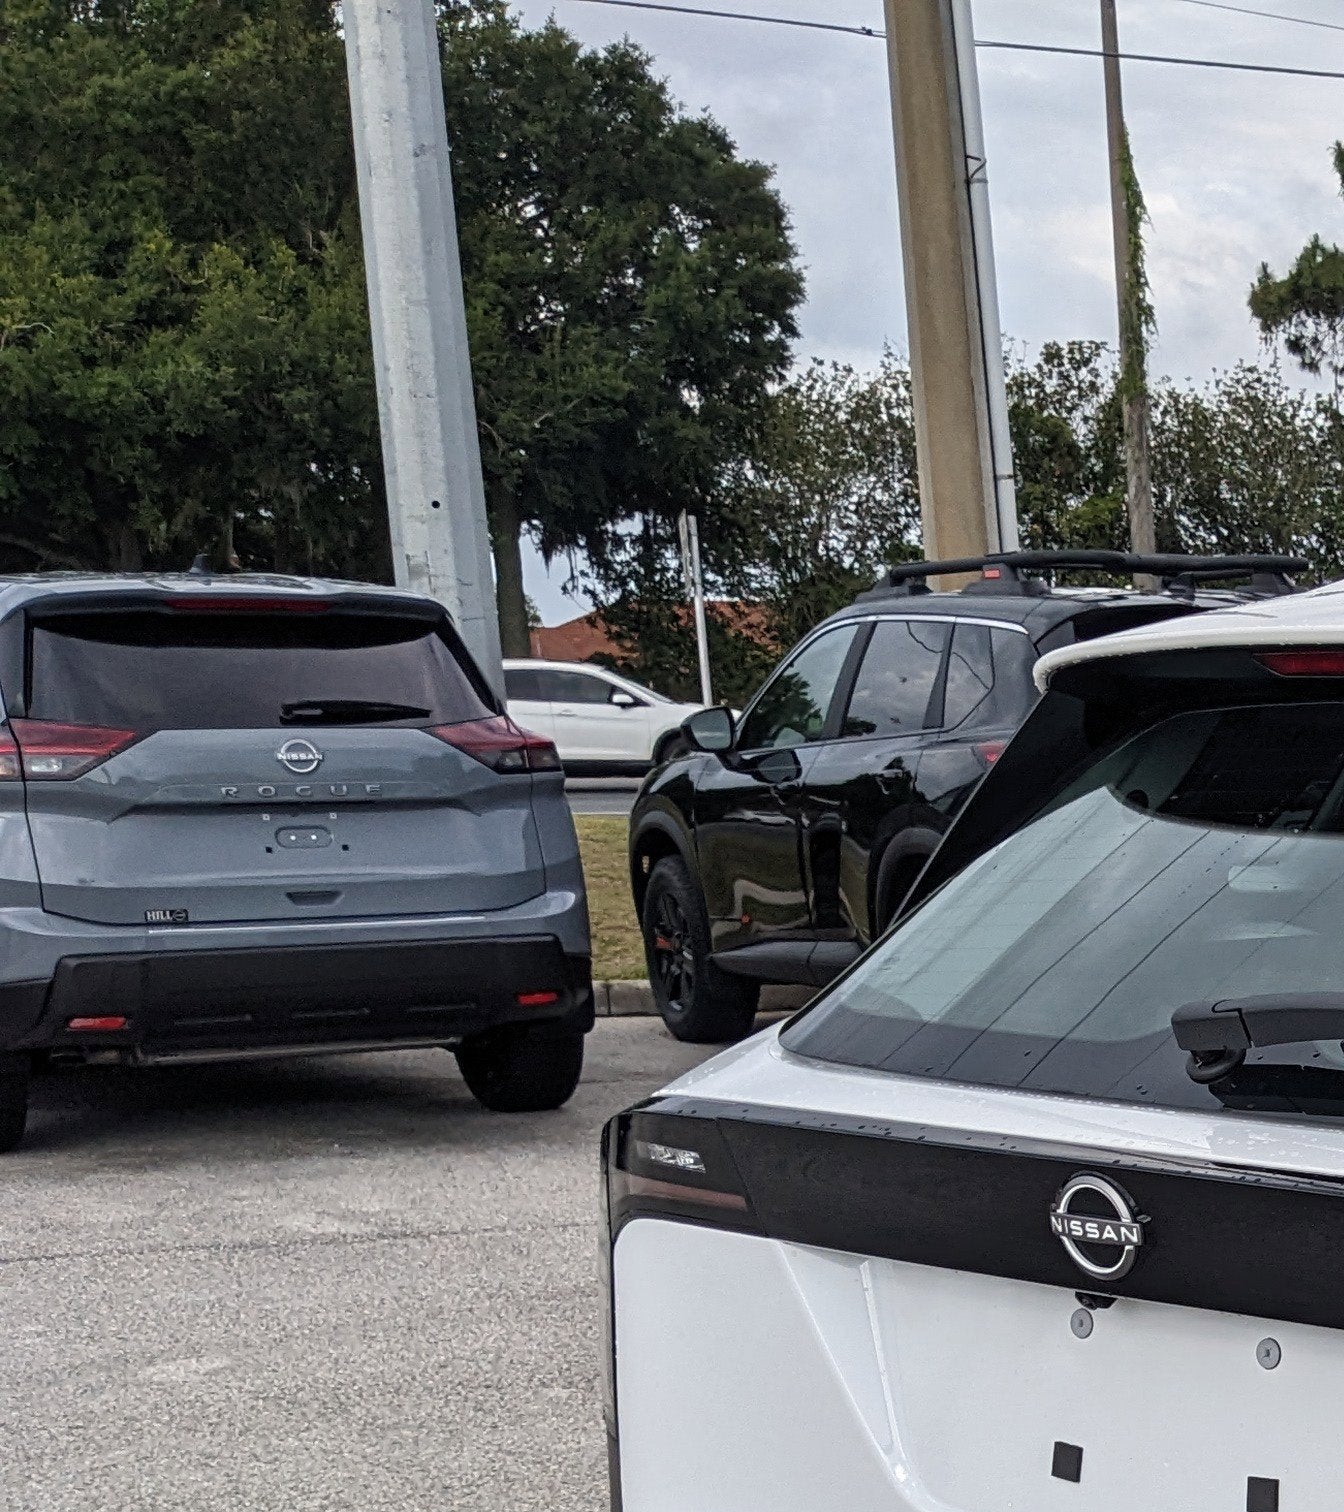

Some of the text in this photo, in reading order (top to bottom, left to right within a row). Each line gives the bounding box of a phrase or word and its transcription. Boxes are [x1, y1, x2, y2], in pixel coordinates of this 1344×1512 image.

[276, 751, 324, 761] NISSAN
[220, 783, 382, 798] ROGUE
[1050, 1215, 1140, 1244] NISSAN
